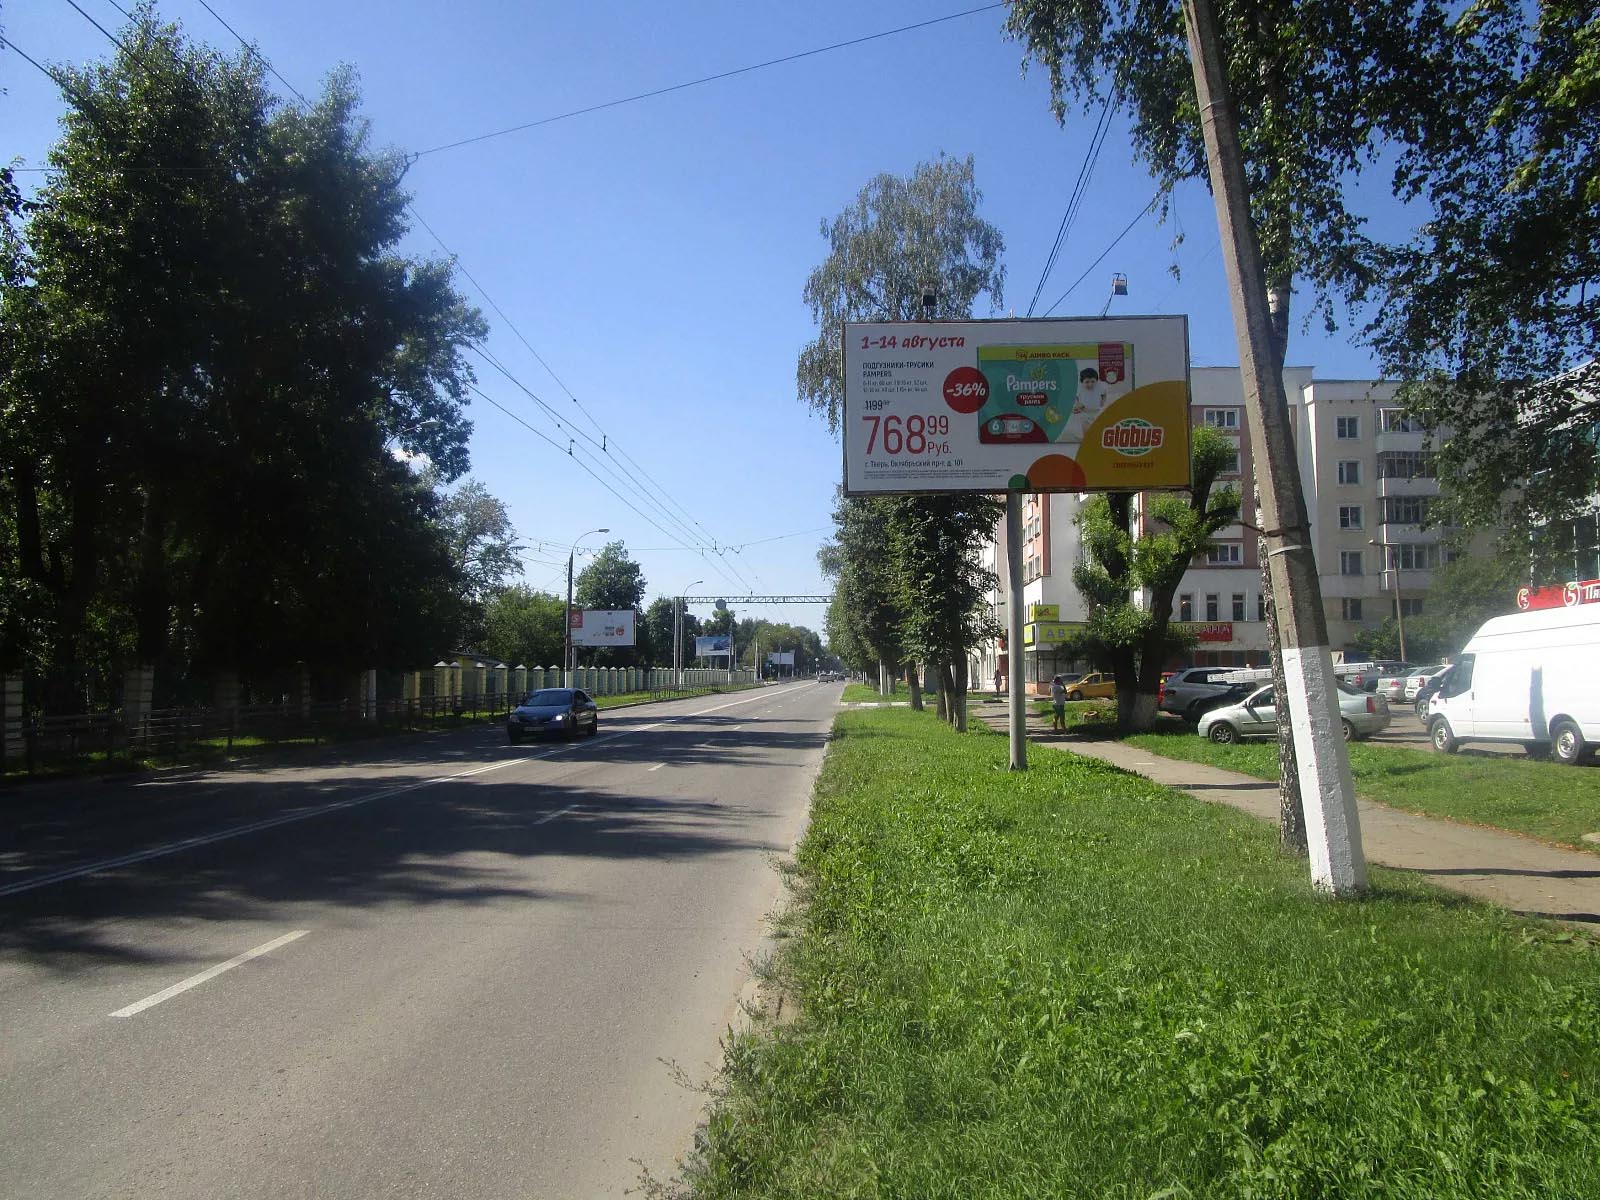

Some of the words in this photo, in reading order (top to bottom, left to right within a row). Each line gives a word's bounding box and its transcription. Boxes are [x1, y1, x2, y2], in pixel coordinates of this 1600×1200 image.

[902, 334, 966, 351] августа
[862, 361, 934, 370] ПОДГУЗНИКИ-ТРУСИКИ
[862, 370, 892, 378] PAMPERS
[946, 382, 986, 398] -36%
[1006, 375, 1057, 393] Pampers
[865, 399, 883, 411] 1199
[992, 420, 1000, 431] 6
[862, 414, 927, 455] 768
[927, 415, 949, 436] 99
[927, 441, 952, 457] Руб.
[890, 459, 930, 468] Октябрьский
